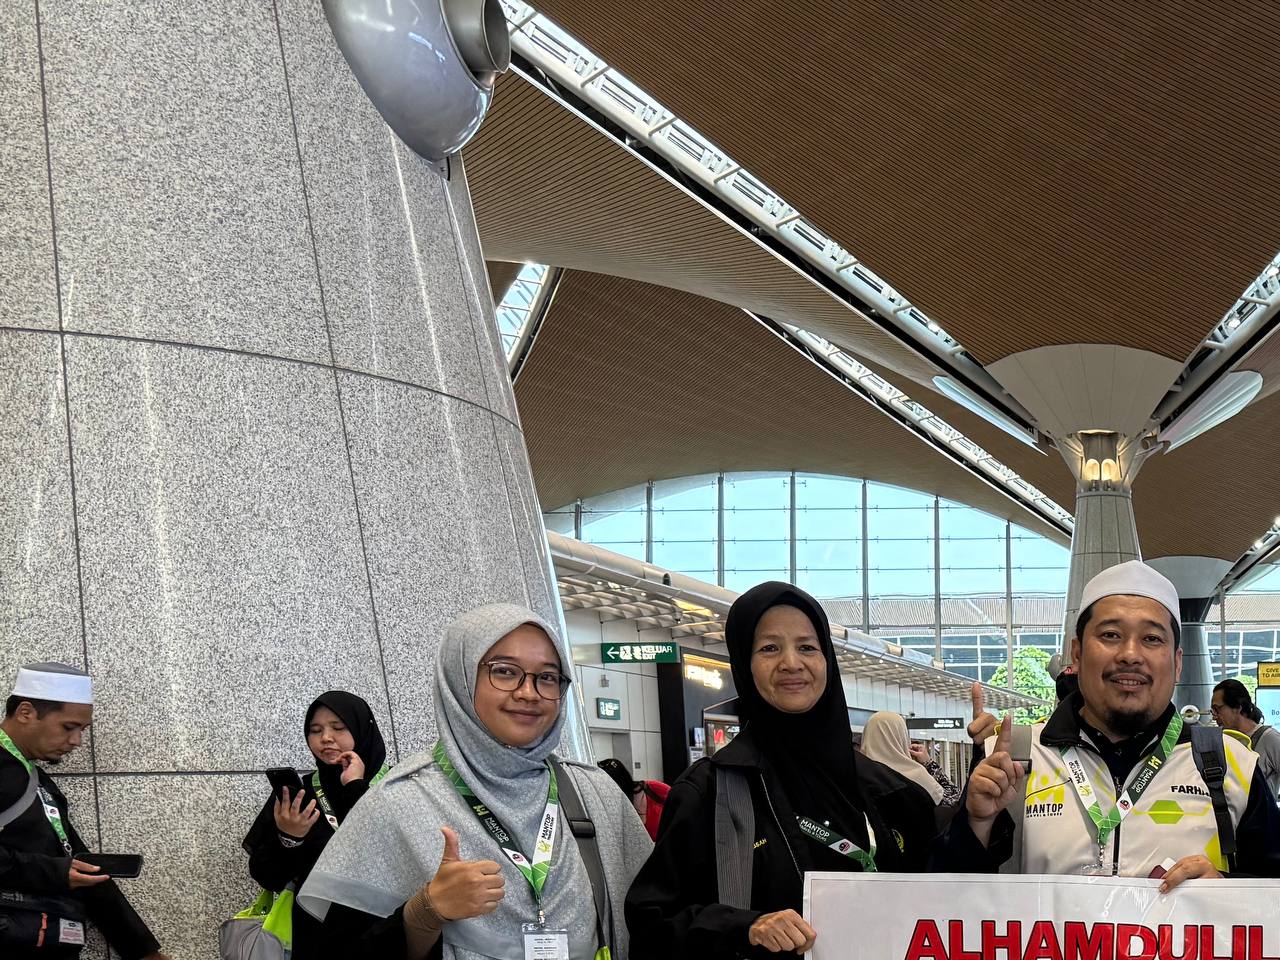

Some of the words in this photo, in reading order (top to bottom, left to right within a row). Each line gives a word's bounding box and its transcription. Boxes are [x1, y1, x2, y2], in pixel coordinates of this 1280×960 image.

[1026, 803, 1064, 815] MANTOP
[489, 817, 510, 842] MANTOP
[541, 813, 551, 840] MANTOP
[800, 819, 830, 837] MANTOP
